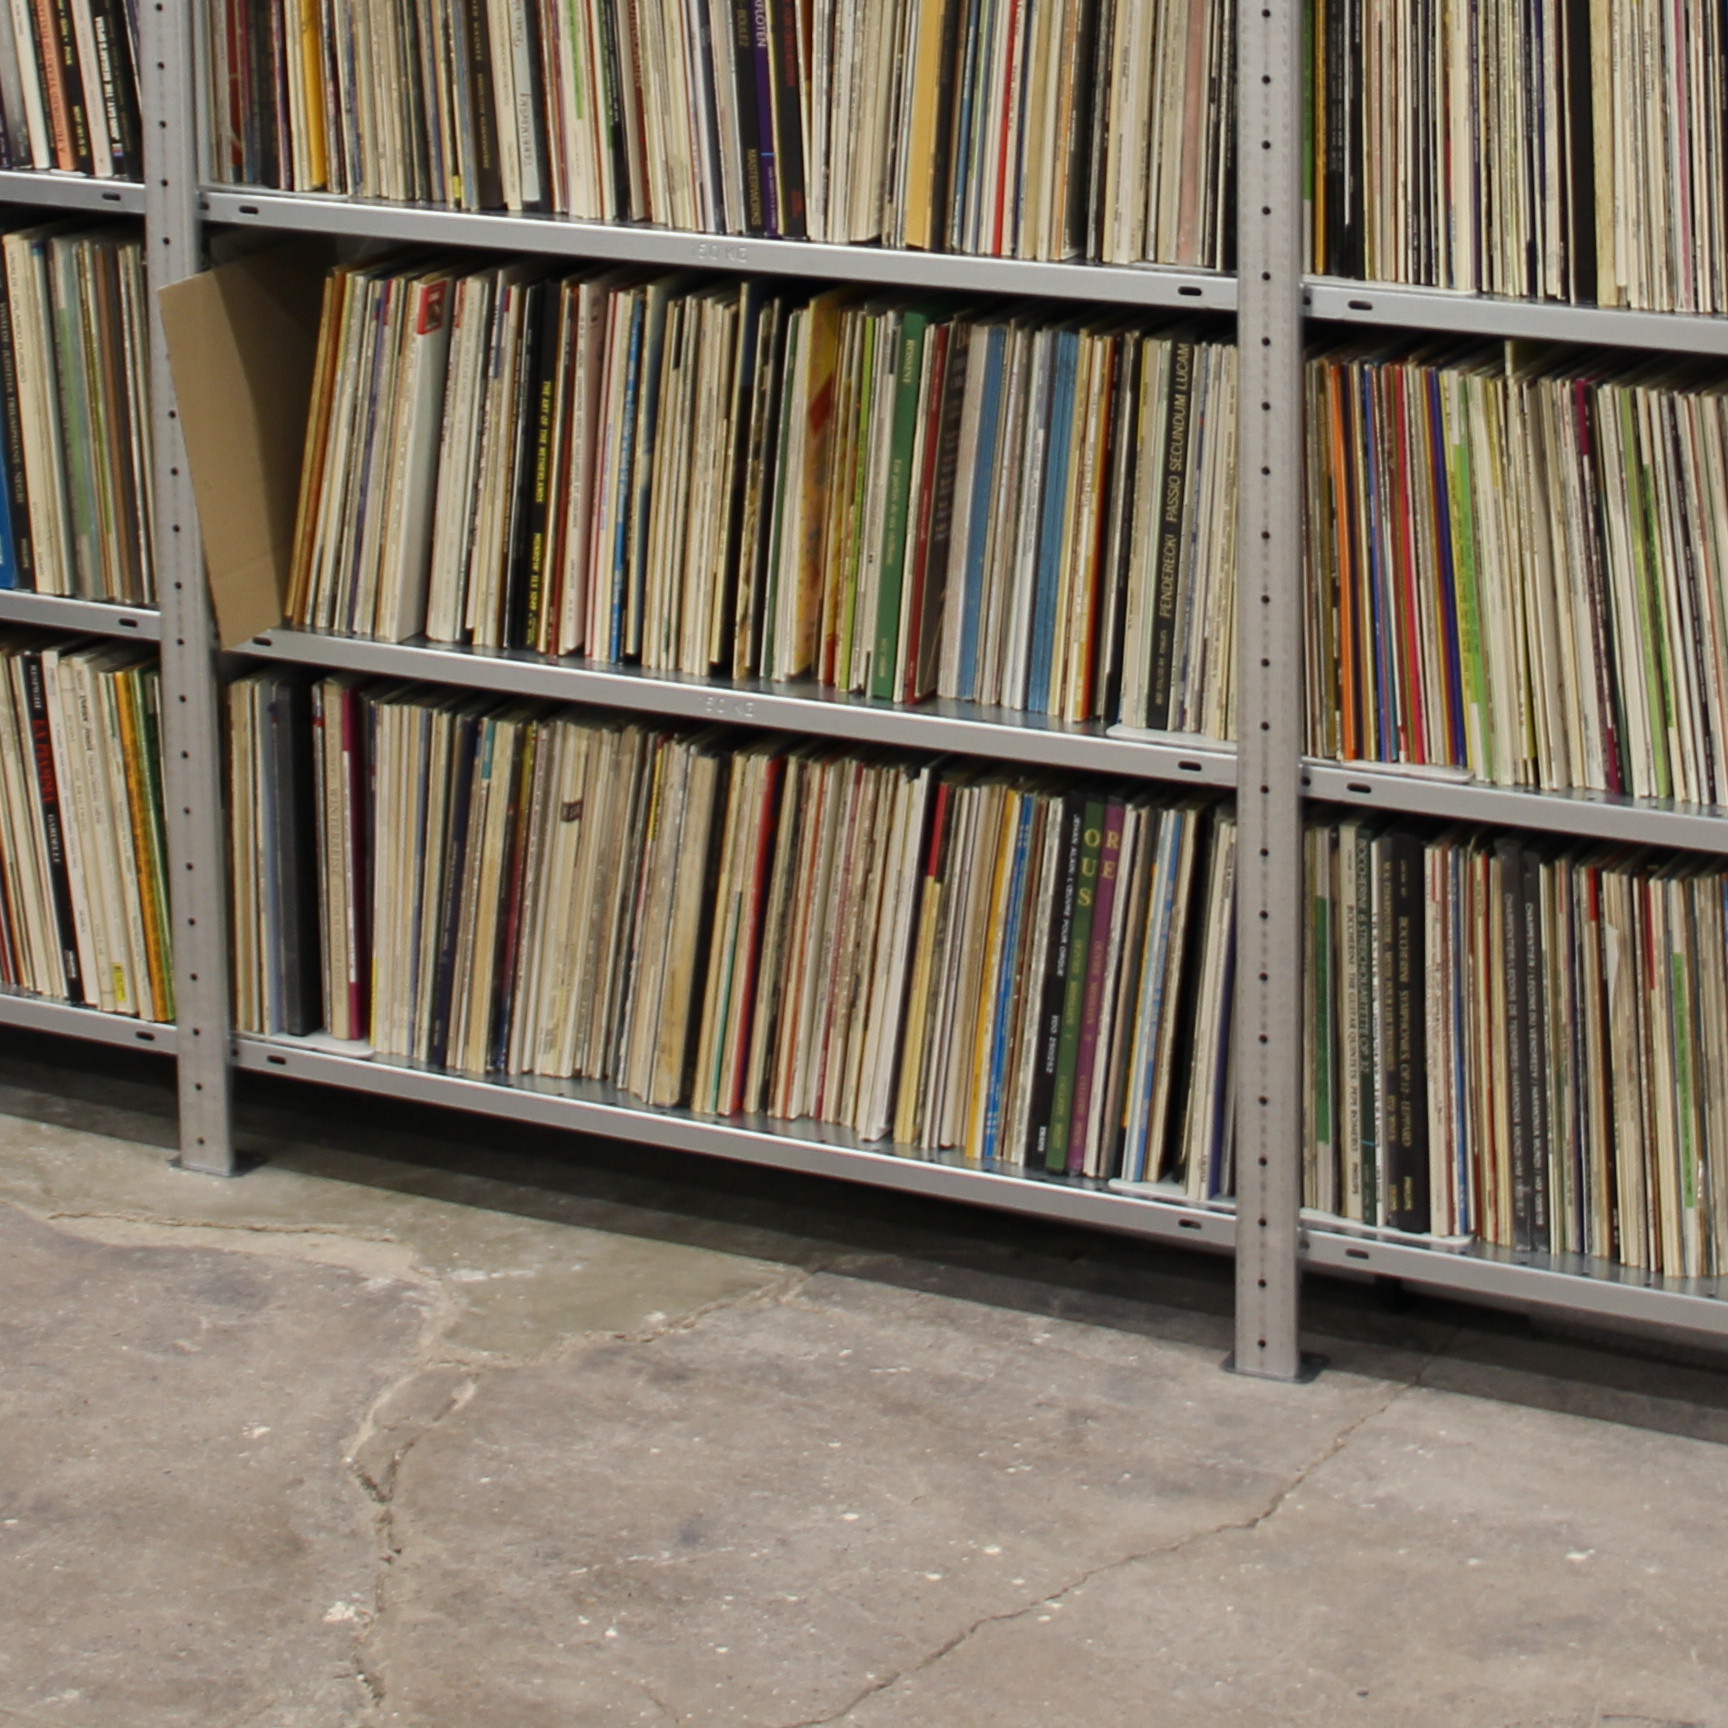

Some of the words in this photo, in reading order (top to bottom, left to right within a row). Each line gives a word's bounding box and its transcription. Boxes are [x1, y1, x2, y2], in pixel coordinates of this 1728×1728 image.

[1174, 344, 1188, 390] LUCAM
[1169, 395, 1185, 471] SECUNDUM
[1166, 476, 1180, 522] PASSIO
[1160, 535, 1176, 617] PENDERECKI
